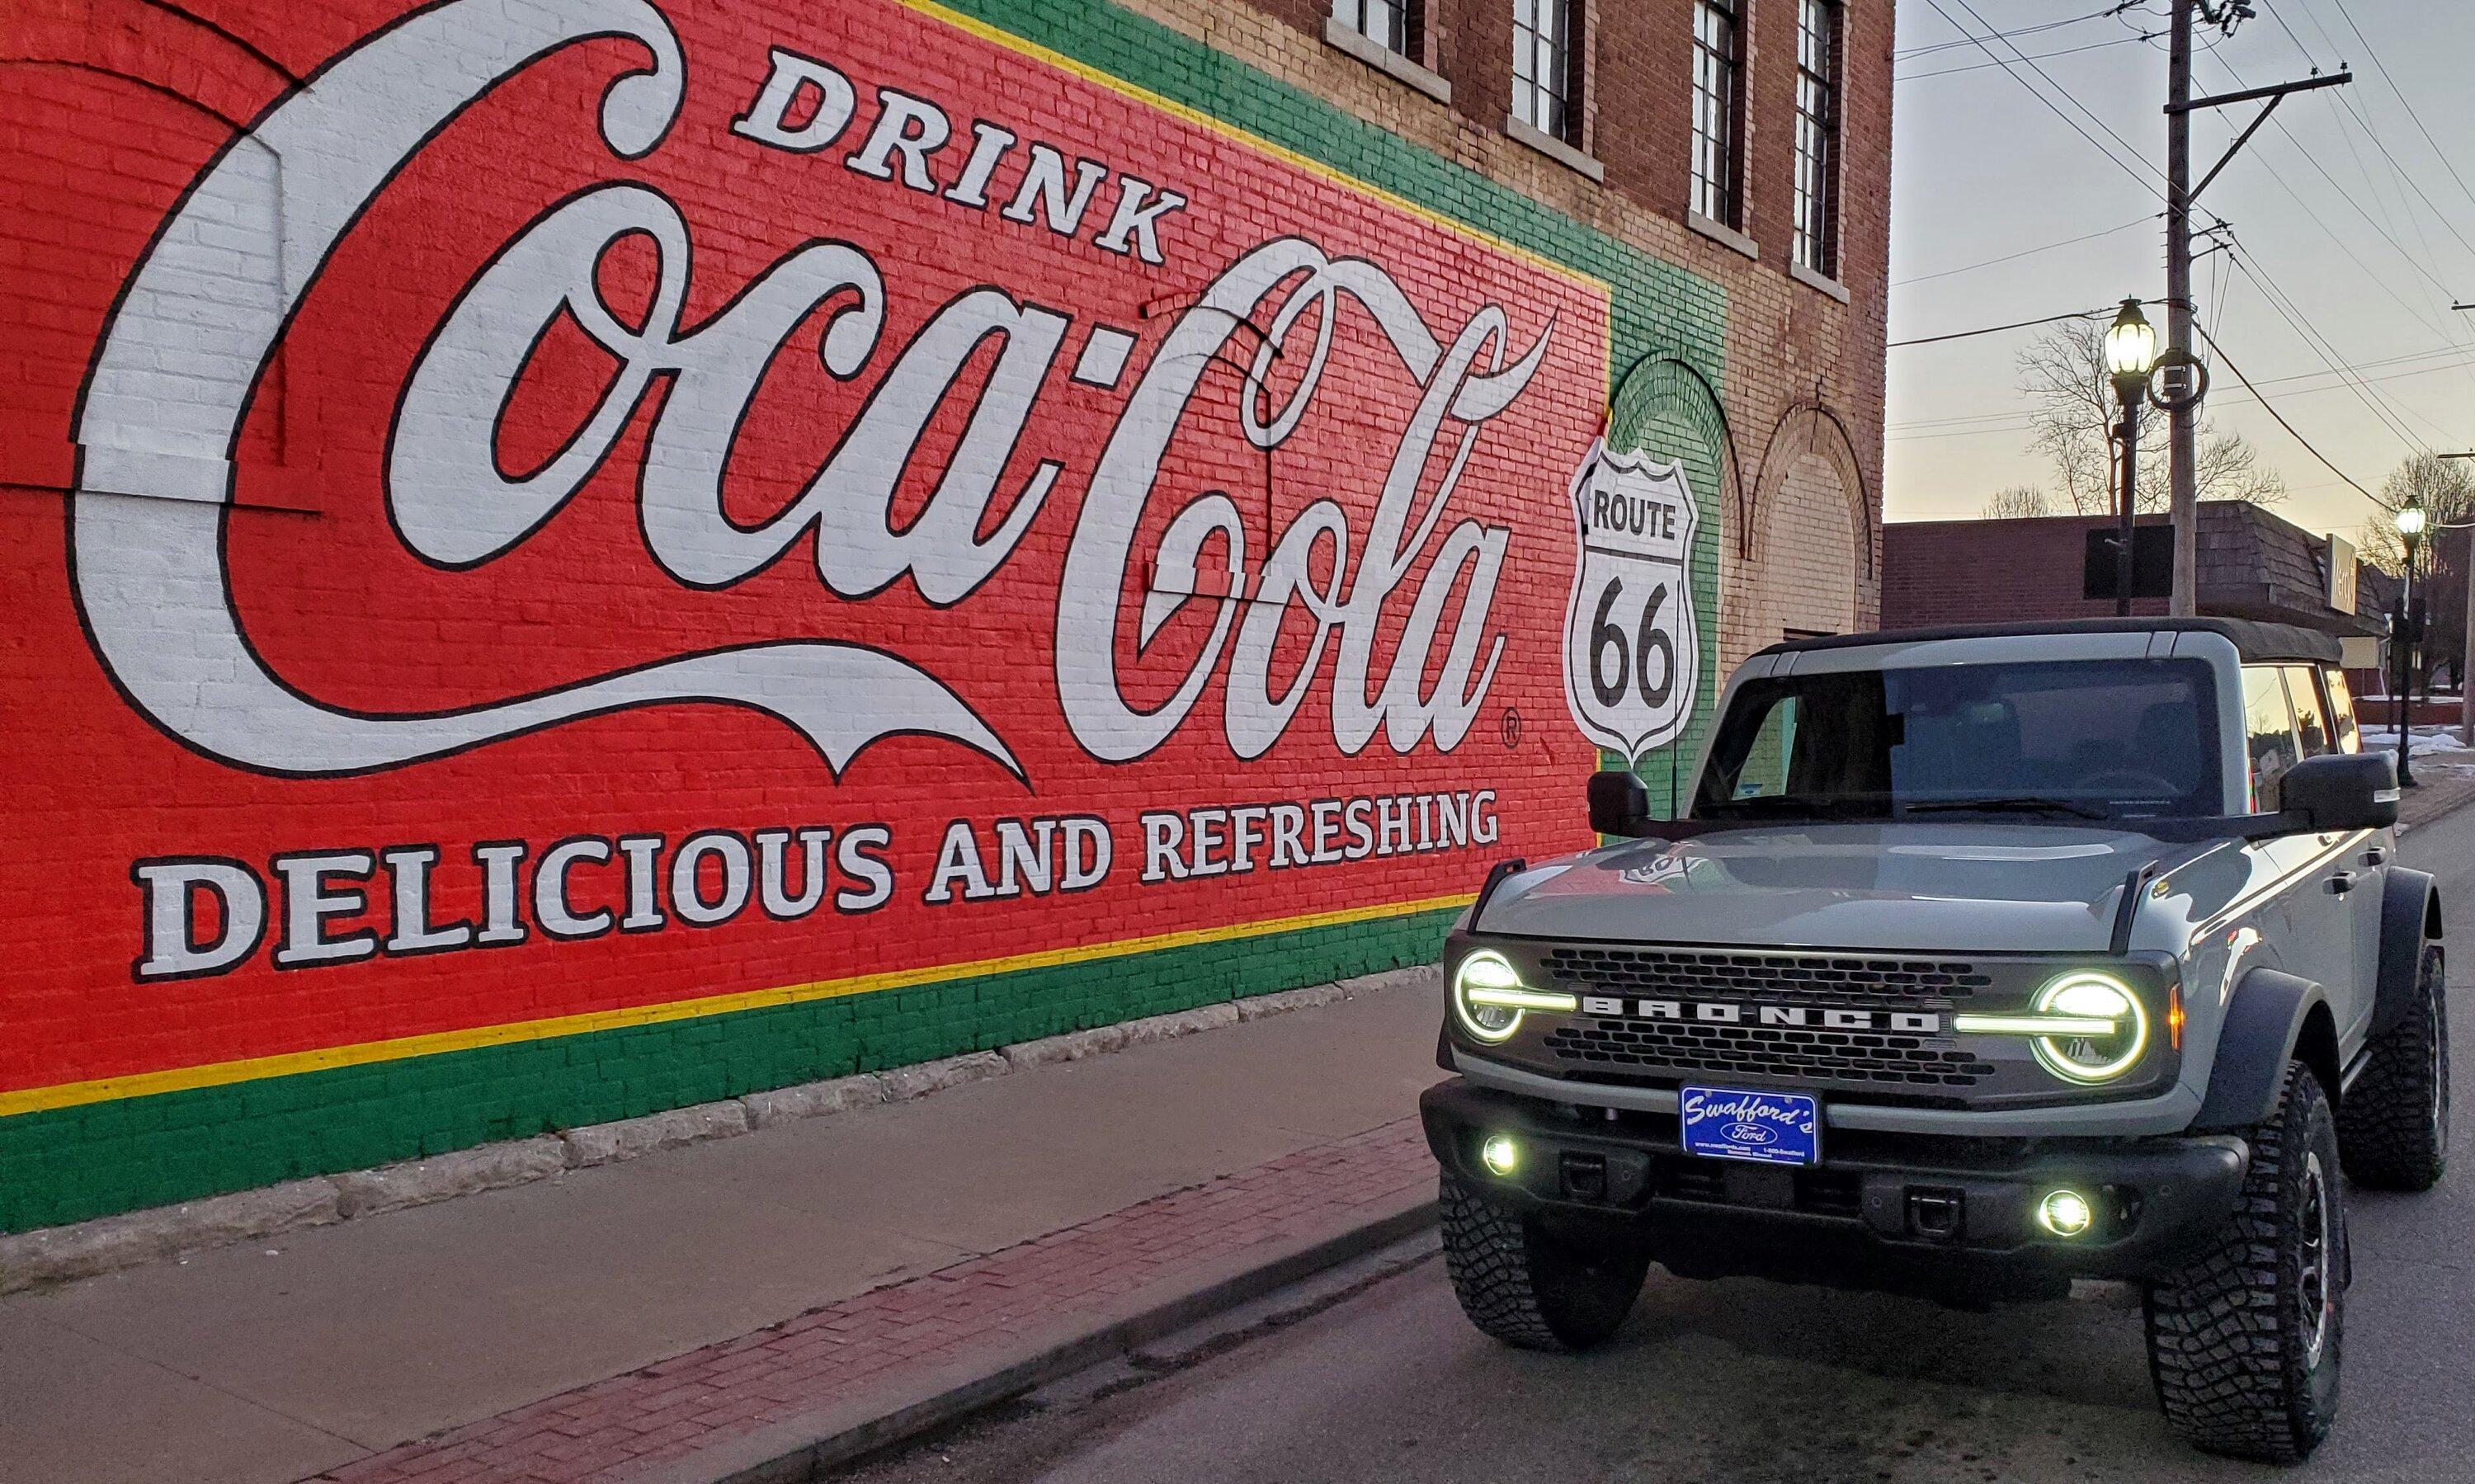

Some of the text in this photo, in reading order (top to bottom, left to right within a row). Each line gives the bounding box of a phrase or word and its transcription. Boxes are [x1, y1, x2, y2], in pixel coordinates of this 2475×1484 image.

[728, 45, 1188, 267] DRINK
[1593, 489, 1676, 540] ROUTE
[1590, 576, 1674, 709] 66
[130, 789, 1499, 984] DELICIOUS AND REFRESHING
[1582, 996, 1940, 1033] BRONCO
[1685, 1095, 1813, 1133] Swafford's
[1731, 1124, 1767, 1142] Ford
